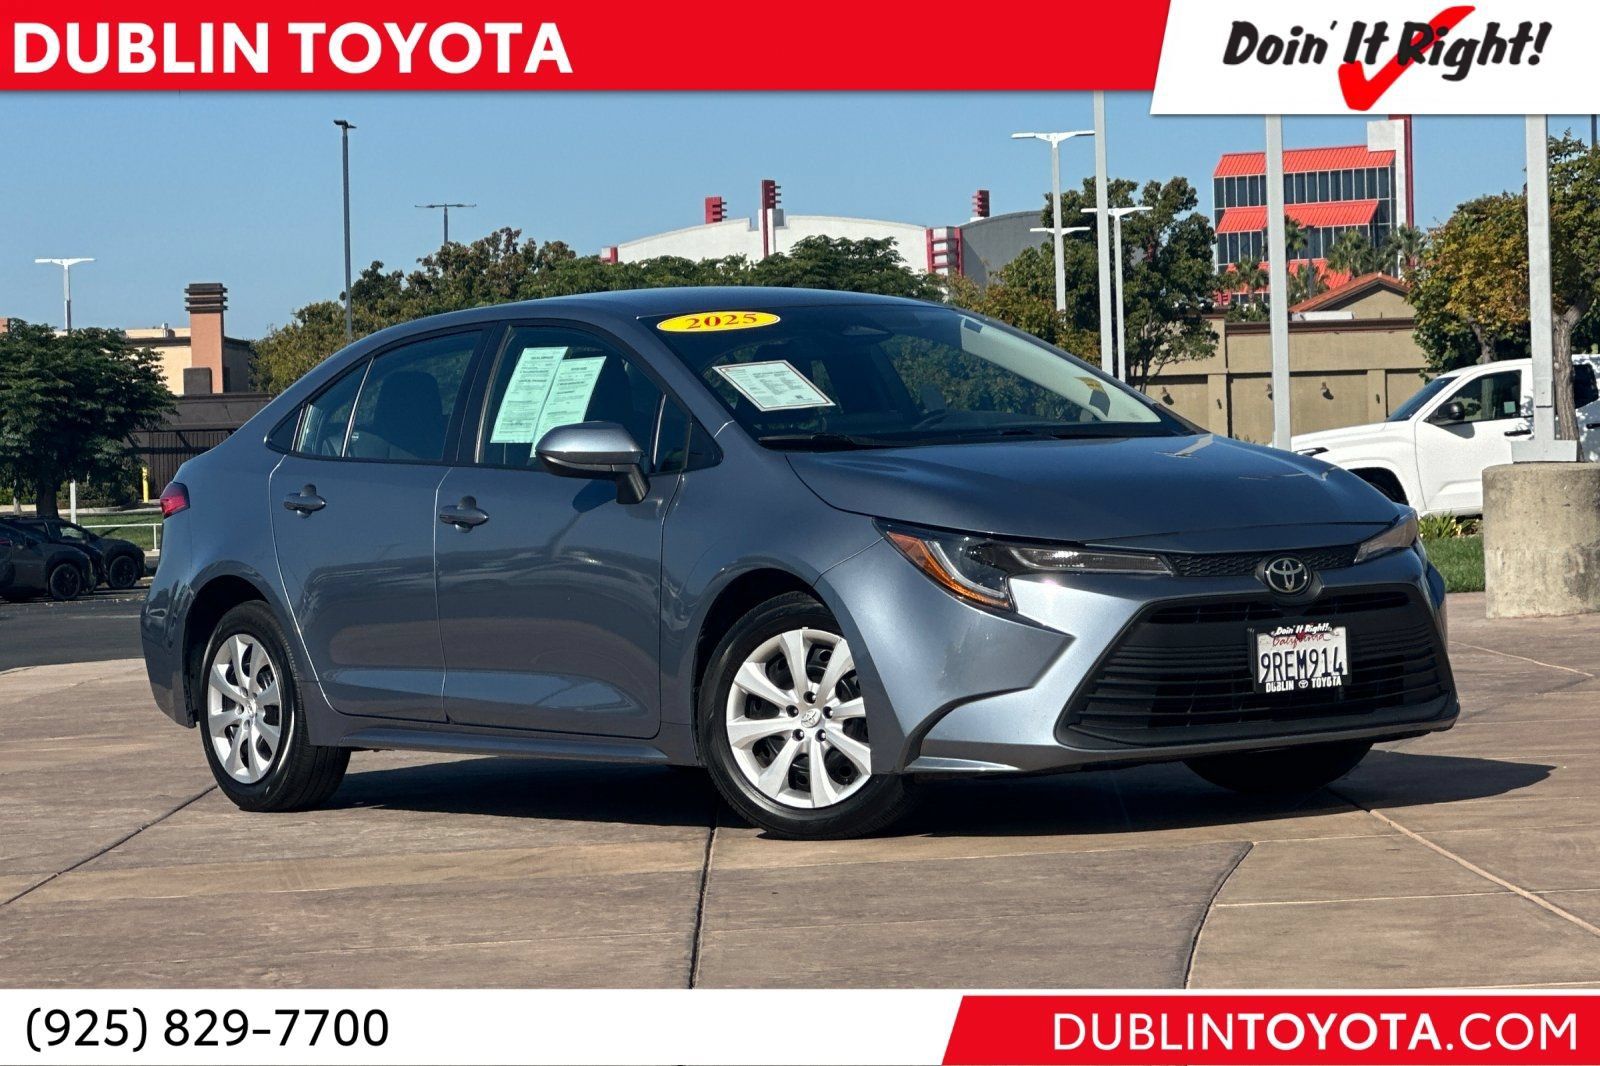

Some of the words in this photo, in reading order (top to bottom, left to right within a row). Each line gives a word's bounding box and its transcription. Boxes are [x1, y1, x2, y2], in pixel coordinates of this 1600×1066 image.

[686, 313, 757, 329] 2025
[1261, 647, 1343, 683] 9REM914
[1265, 680, 1294, 693] DUBLIN
[1311, 676, 1342, 688] TOYOTA
